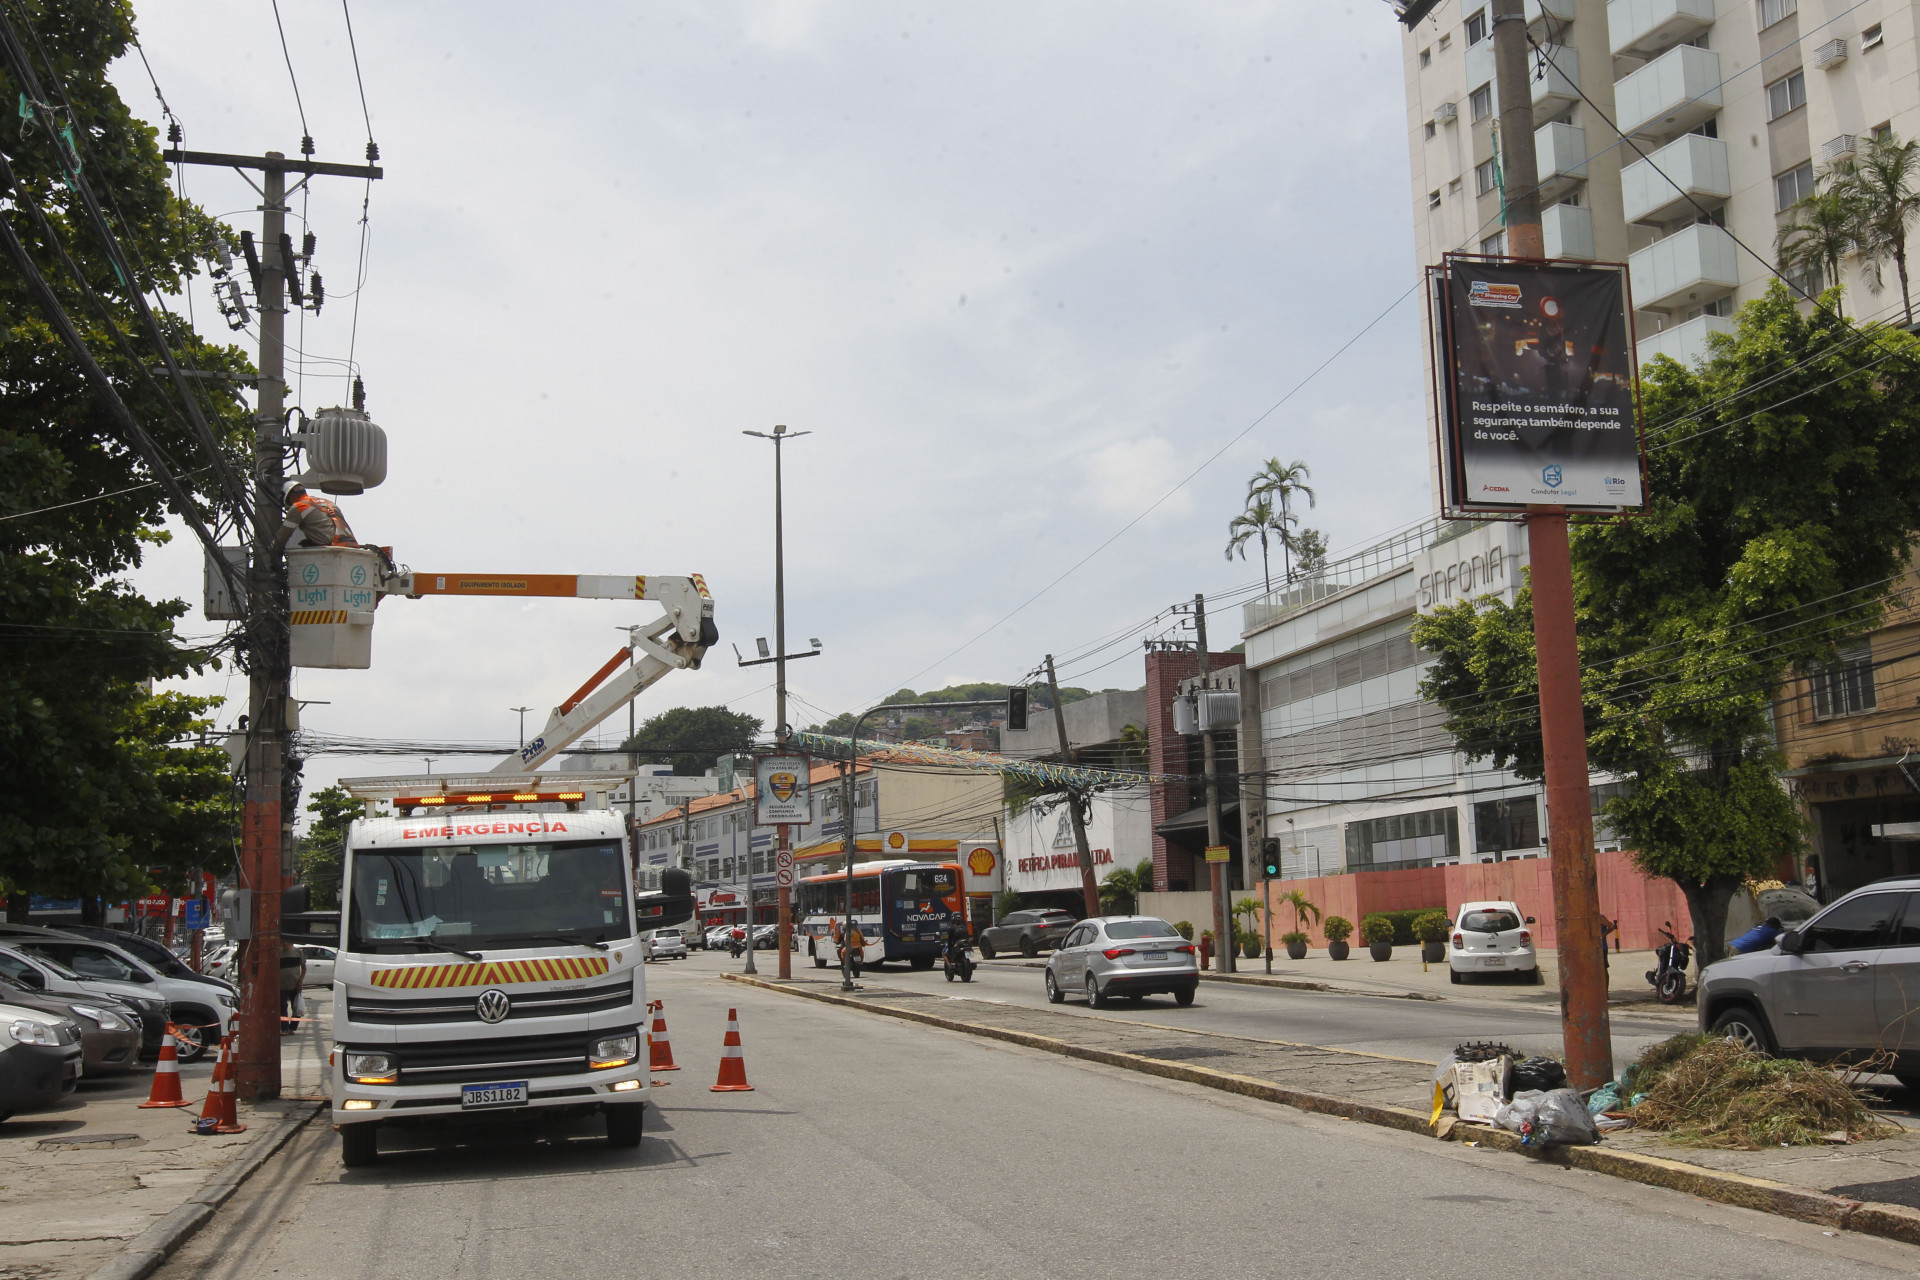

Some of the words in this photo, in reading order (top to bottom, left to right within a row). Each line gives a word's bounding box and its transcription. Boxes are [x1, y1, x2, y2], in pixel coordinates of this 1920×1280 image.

[1485, 292, 1507, 300] Shopping
[1472, 401, 1522, 413] Respeite
[1524, 404, 1532, 412] o
[1534, 403, 1588, 416] semáforo,
[1590, 407, 1597, 415] a
[1600, 407, 1619, 415] sua
[1473, 417, 1528, 428] segurança
[1529, 418, 1573, 428] também
[1574, 419, 1621, 430] depende
[1474, 430, 1488, 440] de
[1490, 431, 1519, 440] você.
[1612, 477, 1626, 485] Rio
[1561, 489, 1577, 497] Legal
[1420, 545, 1503, 608] SINFONIA
[298, 588, 327, 606] Light
[344, 590, 371, 607] Light
[521, 738, 545, 761] PHD
[1497, 799, 1510, 818] 95
[403, 822, 568, 839] EMERGÊNCIA
[934, 875, 948, 883] 624
[906, 912, 946, 921] NOVACAP
